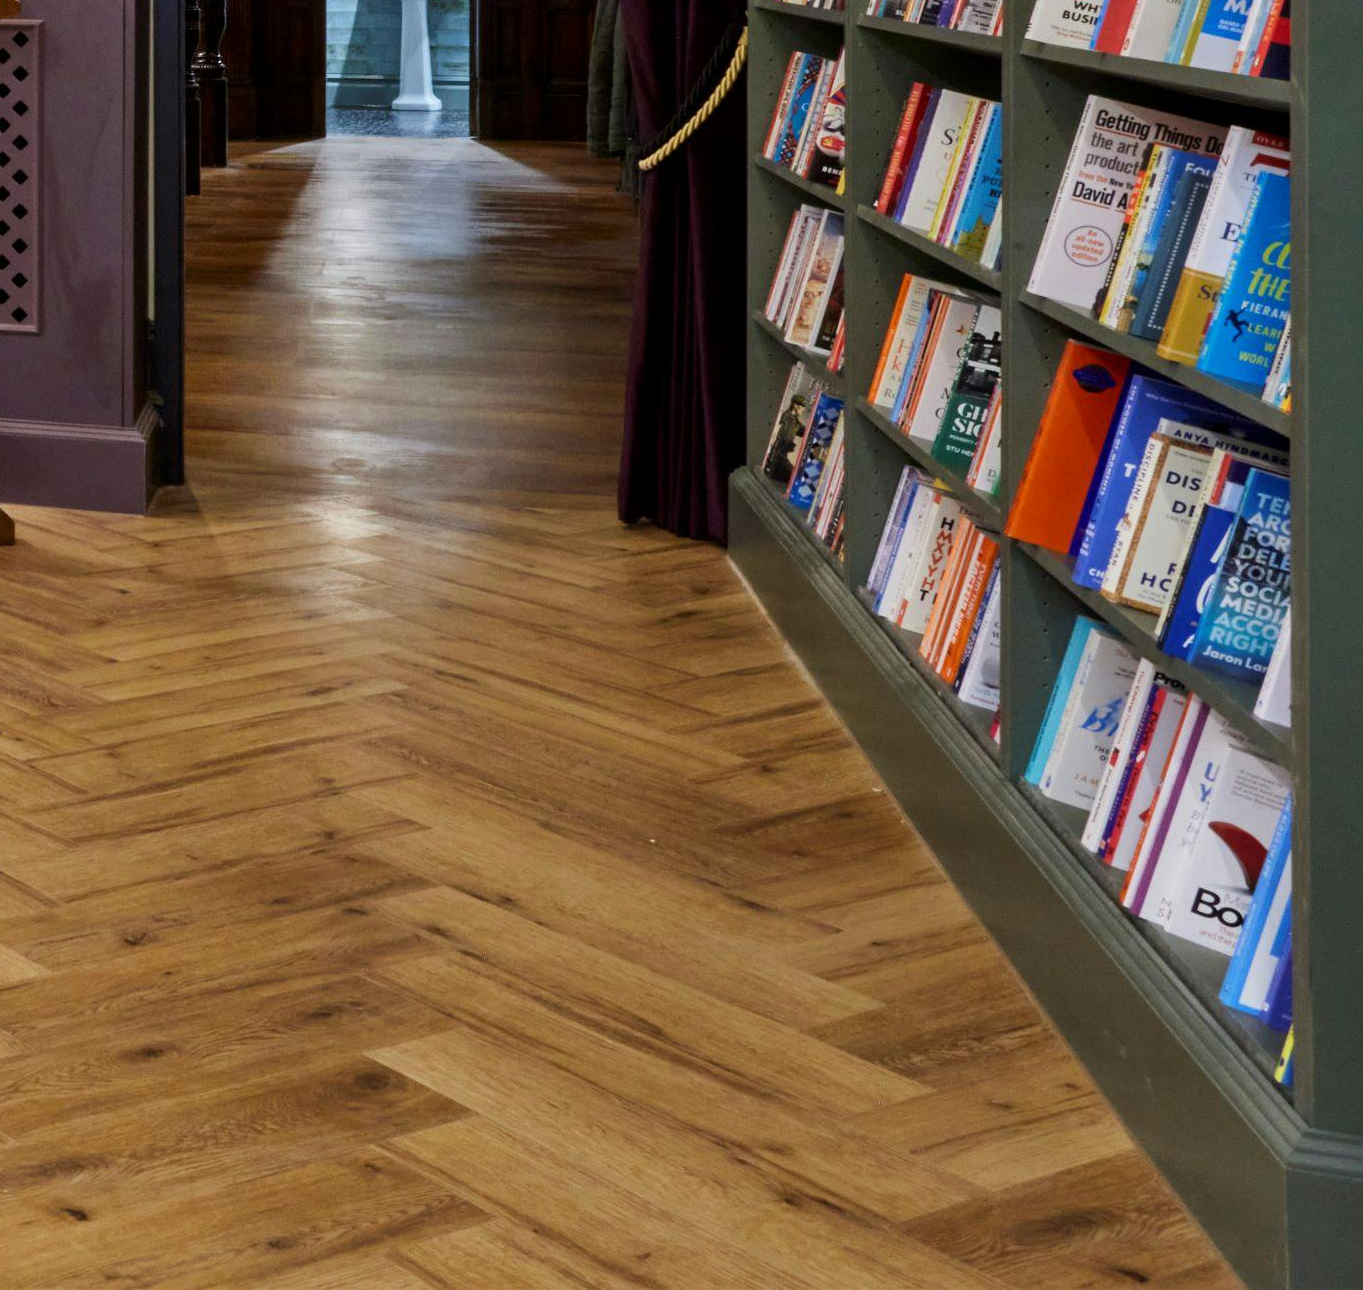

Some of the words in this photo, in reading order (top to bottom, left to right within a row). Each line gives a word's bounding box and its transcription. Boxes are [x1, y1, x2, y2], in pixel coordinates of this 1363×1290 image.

[1095, 109, 1150, 140] Getting
[1154, 123, 1202, 150] Things
[1091, 133, 1112, 150] the
[1117, 142, 1138, 157] art
[1084, 153, 1139, 176] product
[1073, 181, 1112, 206] David
[1174, 429, 1208, 445] ANYA
[1215, 440, 1288, 464] HINDMAR
[1226, 577, 1290, 603] SOCIA
[1203, 645, 1242, 667] Jaron
